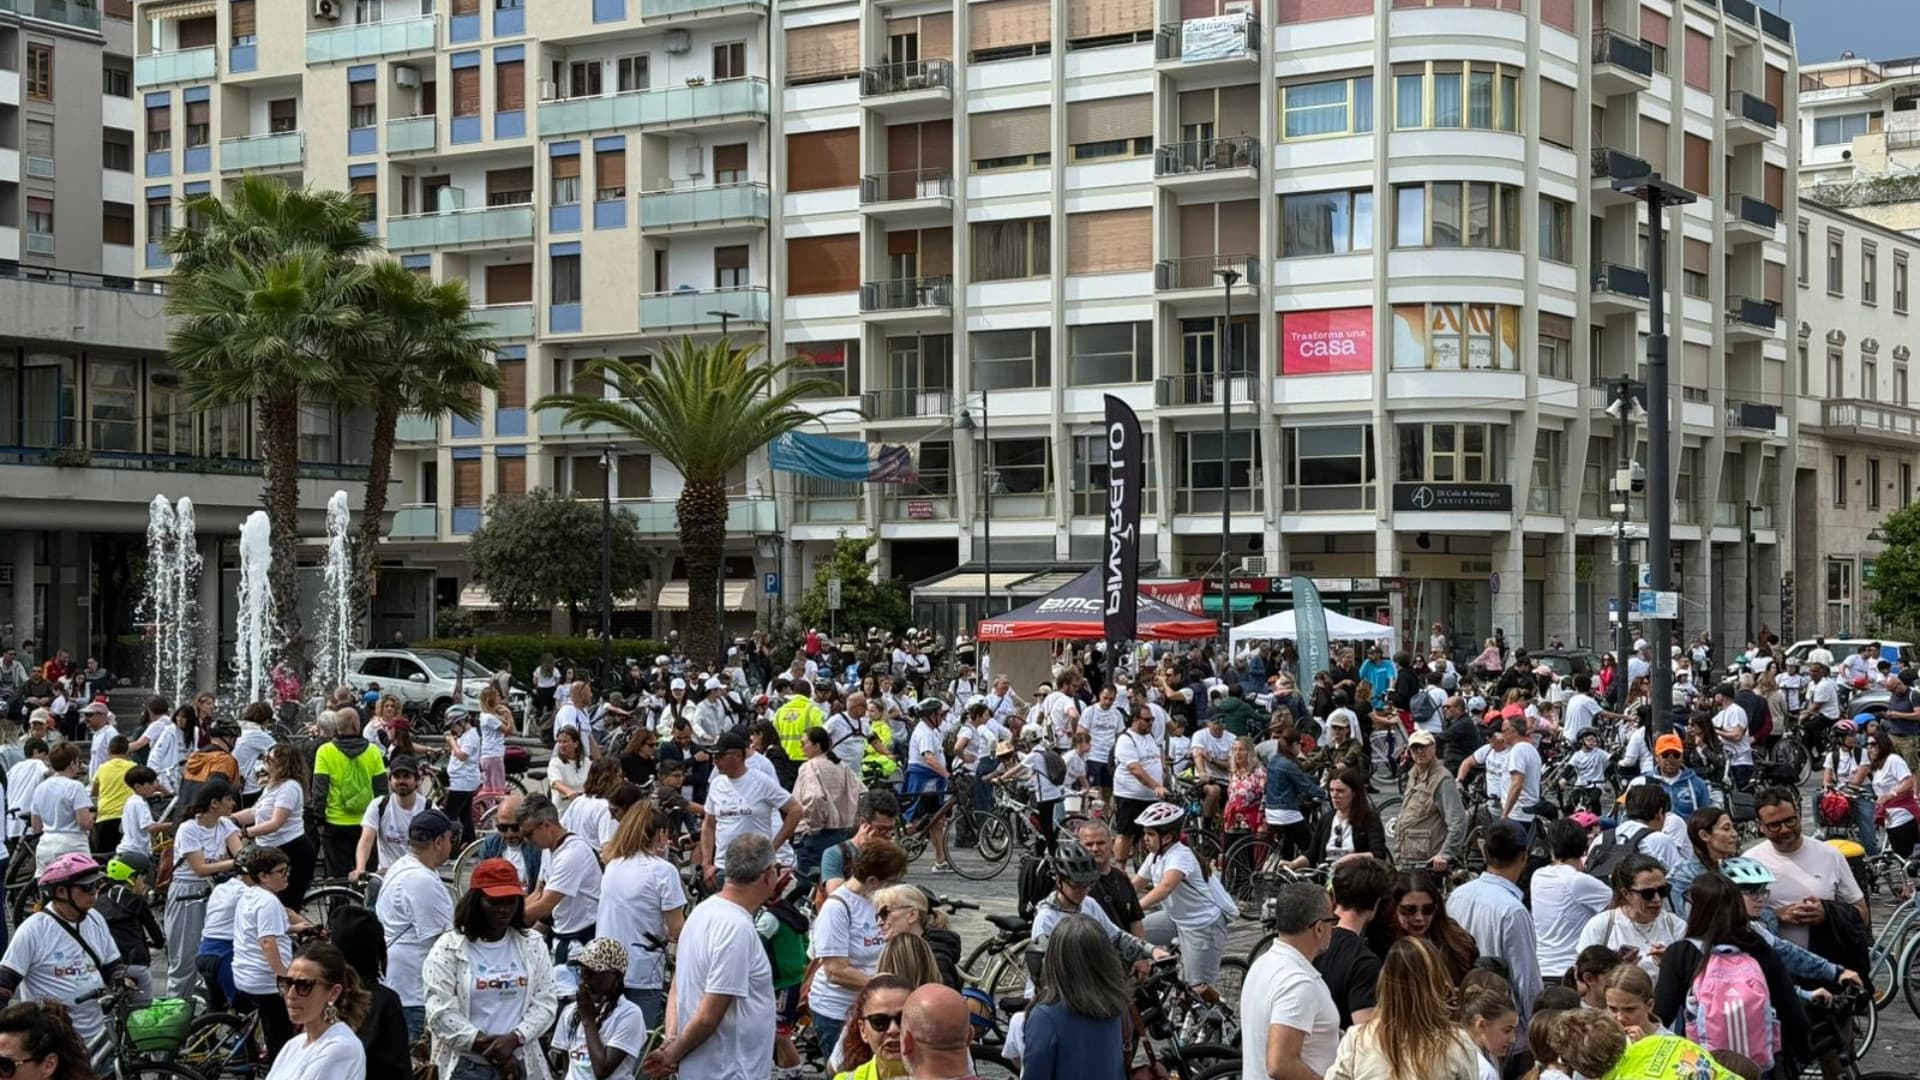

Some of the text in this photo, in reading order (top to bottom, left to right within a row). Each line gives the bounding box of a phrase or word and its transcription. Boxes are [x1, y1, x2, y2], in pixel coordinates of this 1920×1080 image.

[1291, 329, 1367, 341] Trasforma una
[1299, 338, 1357, 358] casa
[1038, 597, 1104, 610] BMC
[981, 623, 1015, 634] BMC
